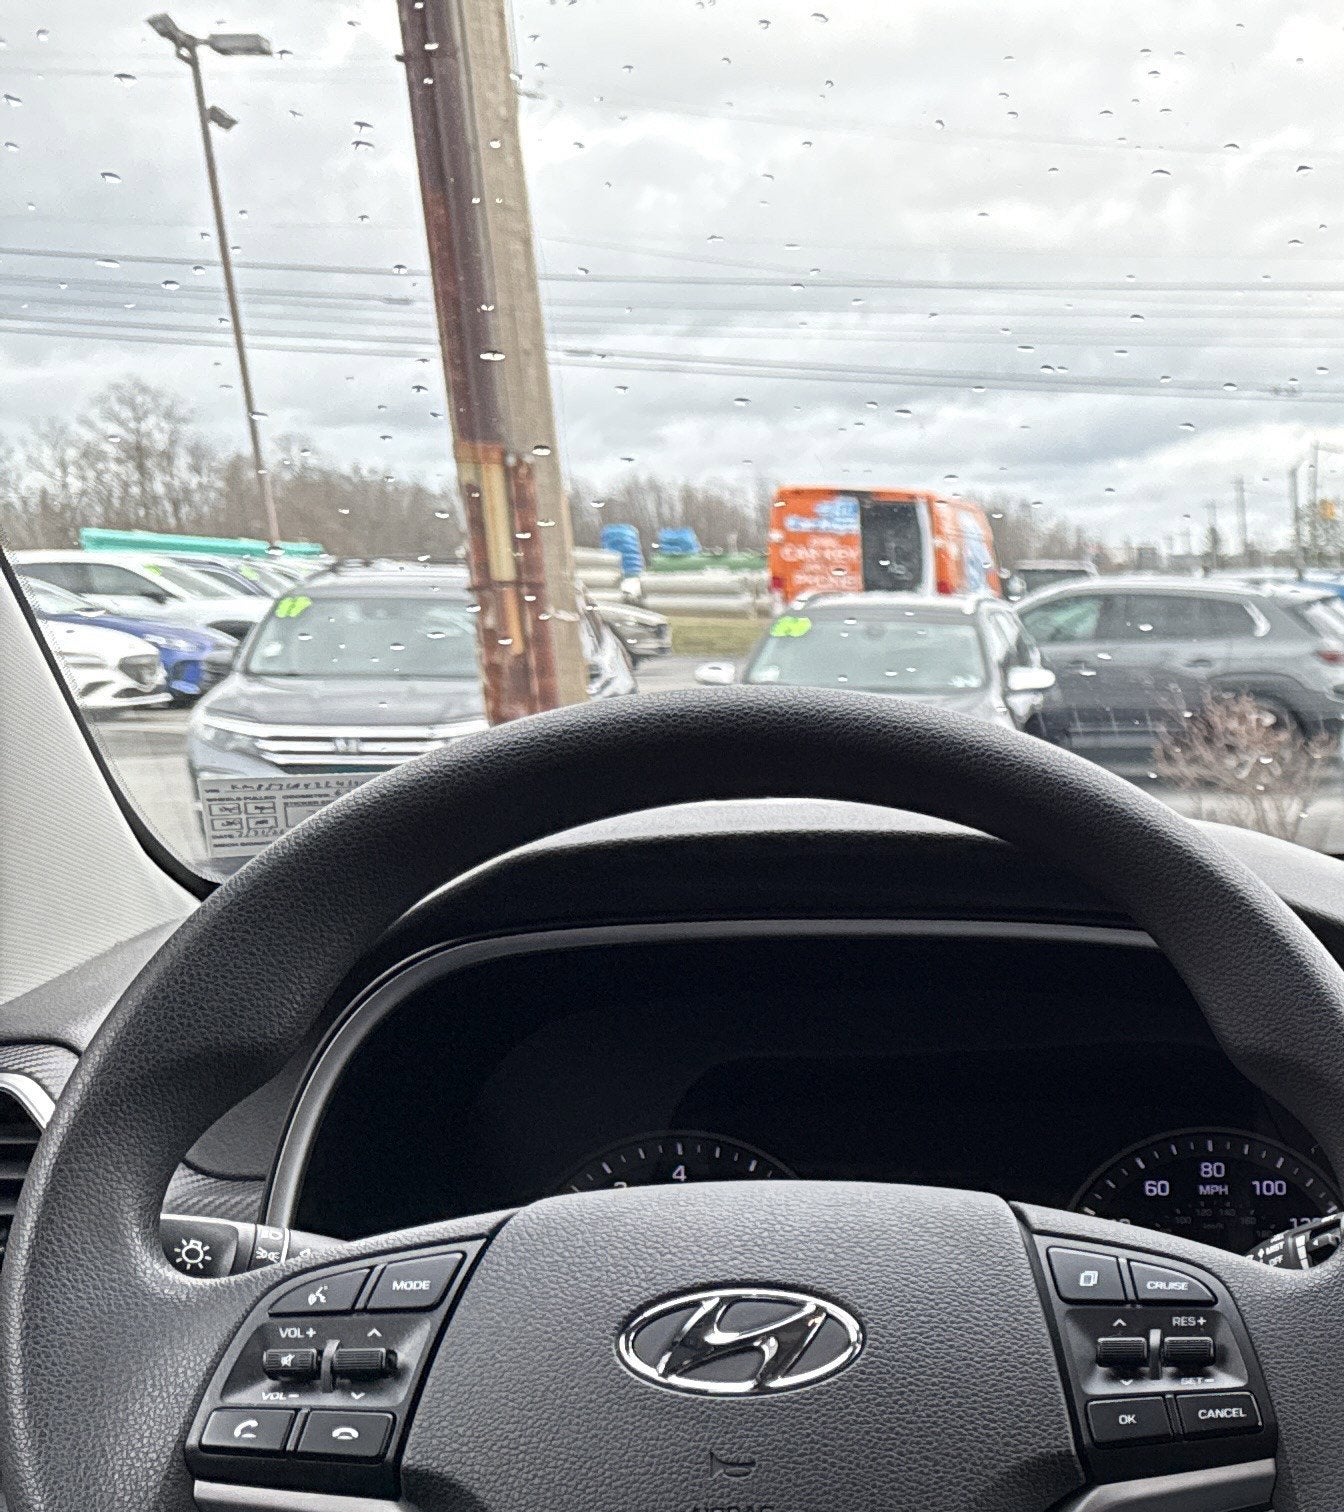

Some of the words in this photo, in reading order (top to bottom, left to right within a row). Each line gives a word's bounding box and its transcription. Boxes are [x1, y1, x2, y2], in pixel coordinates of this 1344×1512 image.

[671, 1164, 687, 1182] 4
[1198, 1161, 1226, 1179] 80
[1143, 1179, 1170, 1197] 60
[1198, 1183, 1229, 1196] MPH
[1251, 1179, 1287, 1197] 100
[392, 1280, 432, 1291] MODE
[1146, 1280, 1189, 1291] CRUISE
[1118, 1414, 1137, 1425] OK
[1197, 1407, 1248, 1420] CANCEL
